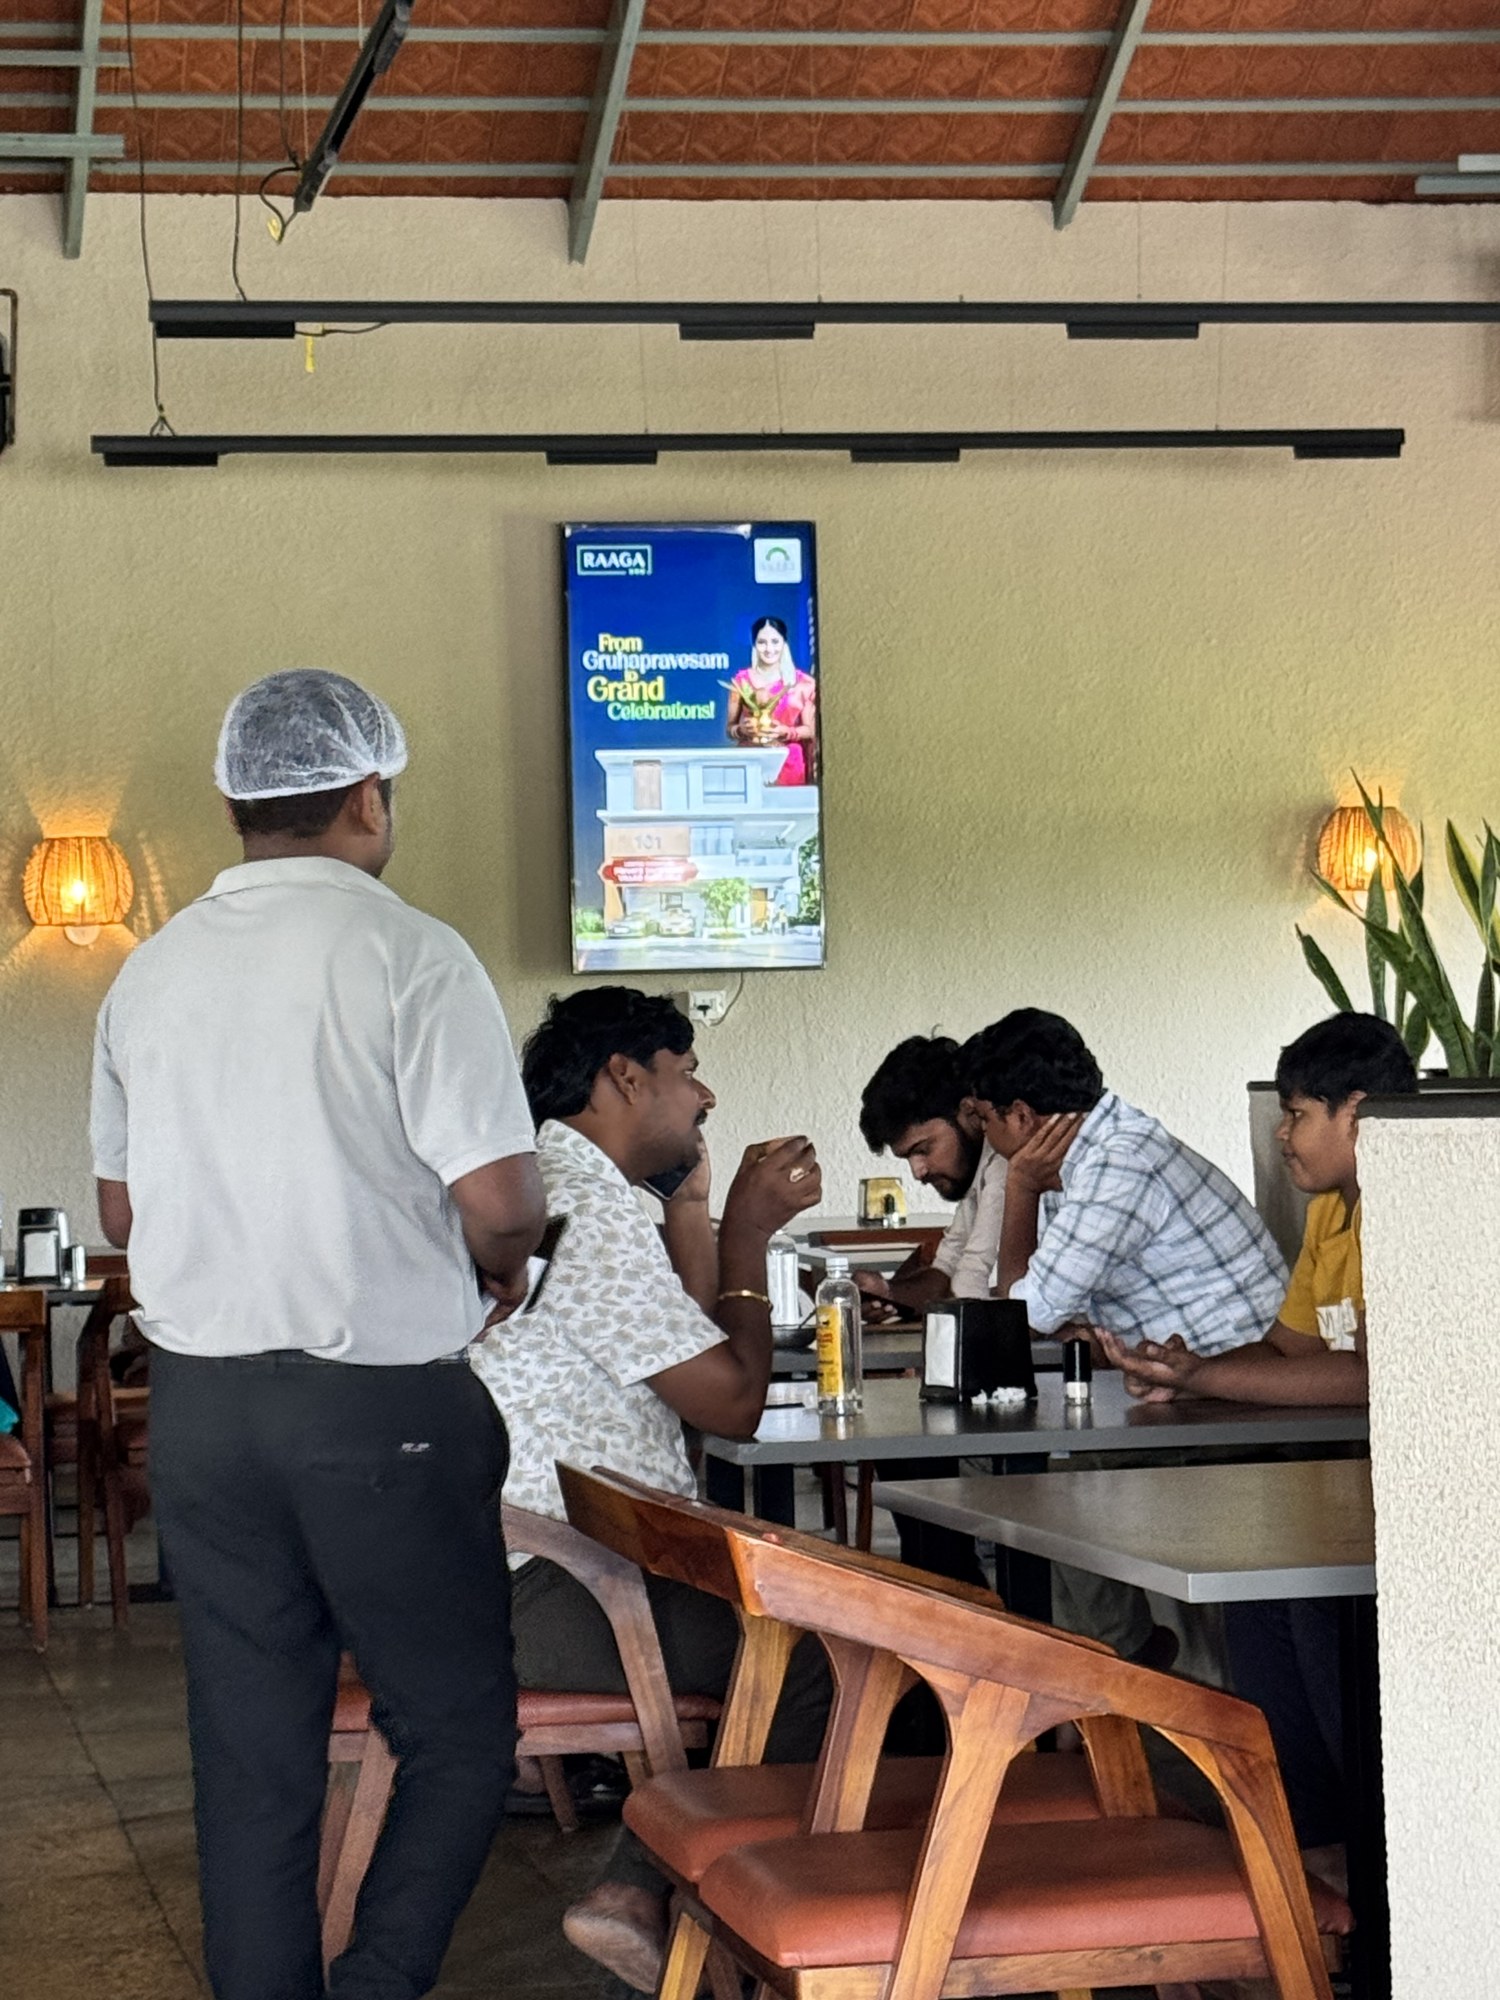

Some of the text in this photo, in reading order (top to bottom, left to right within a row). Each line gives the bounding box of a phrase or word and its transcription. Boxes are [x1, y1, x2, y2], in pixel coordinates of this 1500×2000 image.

[583, 551, 646, 568] RAAGA
[598, 633, 643, 653] From
[582, 650, 729, 674] Gruhapravesam
[587, 675, 665, 702] Grand
[607, 700, 715, 721] Celebrations!
[634, 834, 662, 850] 101
